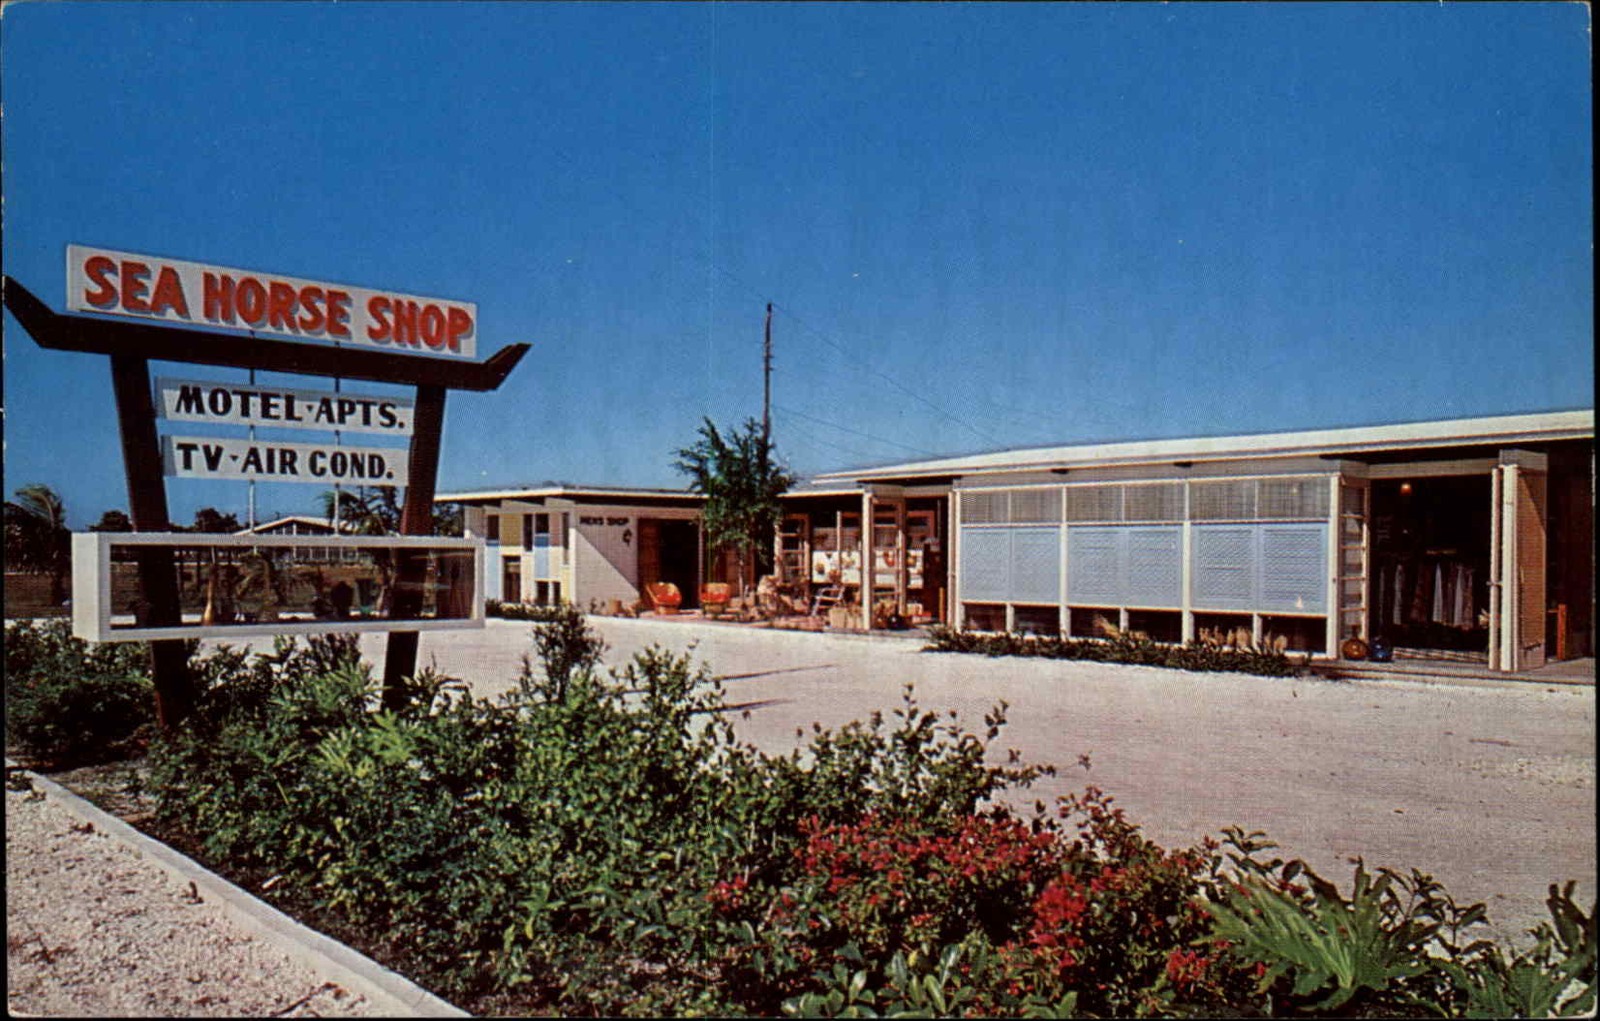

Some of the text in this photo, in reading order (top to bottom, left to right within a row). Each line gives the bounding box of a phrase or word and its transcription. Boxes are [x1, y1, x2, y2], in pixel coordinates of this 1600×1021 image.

[84, 255, 474, 353] SEA HORSE SHOP
[175, 384, 405, 429] MOTEL APTS.
[176, 442, 394, 479] TV AIR COND.
[606, 516, 629, 526] SHOP
